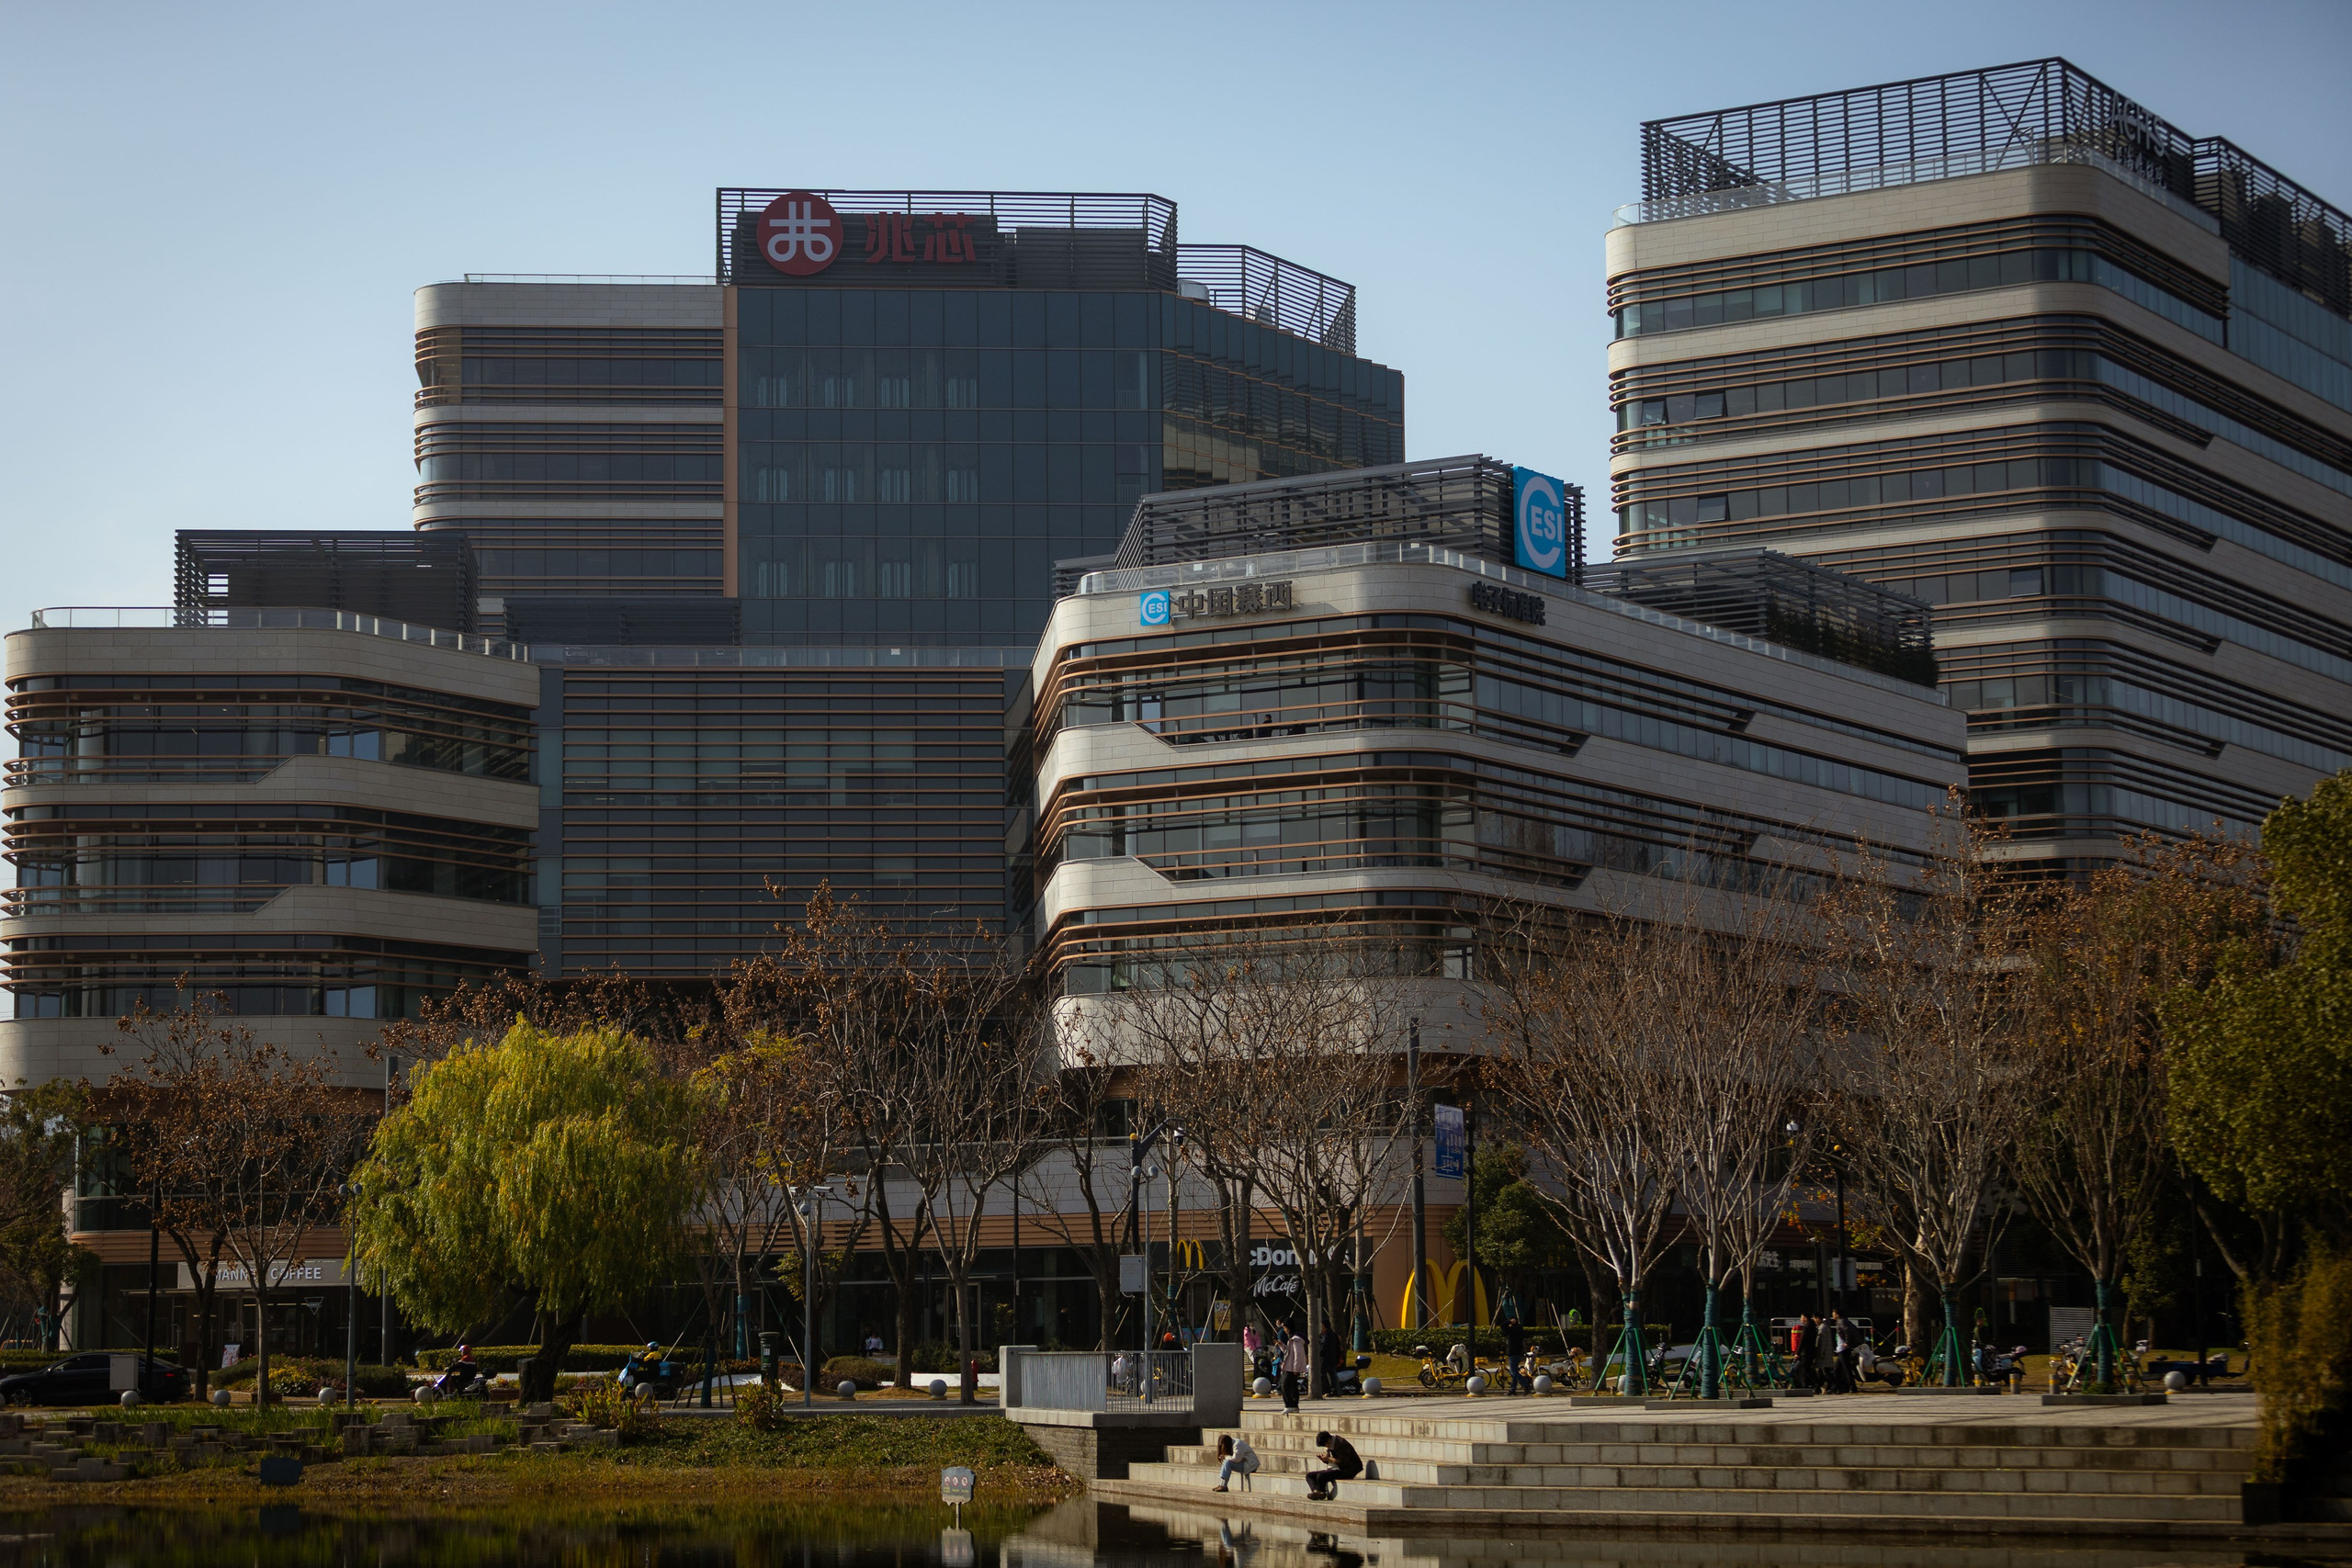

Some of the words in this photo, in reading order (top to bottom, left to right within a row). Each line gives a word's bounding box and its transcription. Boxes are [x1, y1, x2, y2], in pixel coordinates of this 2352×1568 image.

[864, 212, 977, 263] 兆芯
[1519, 475, 1562, 569] CESI
[1141, 592, 1167, 624] CESI
[1178, 581, 1293, 620] 中国赛西
[1472, 581, 1546, 626] 电子标准院
[270, 1267, 322, 1279] COFFEE
[1252, 1274, 1300, 1298] McCafé
